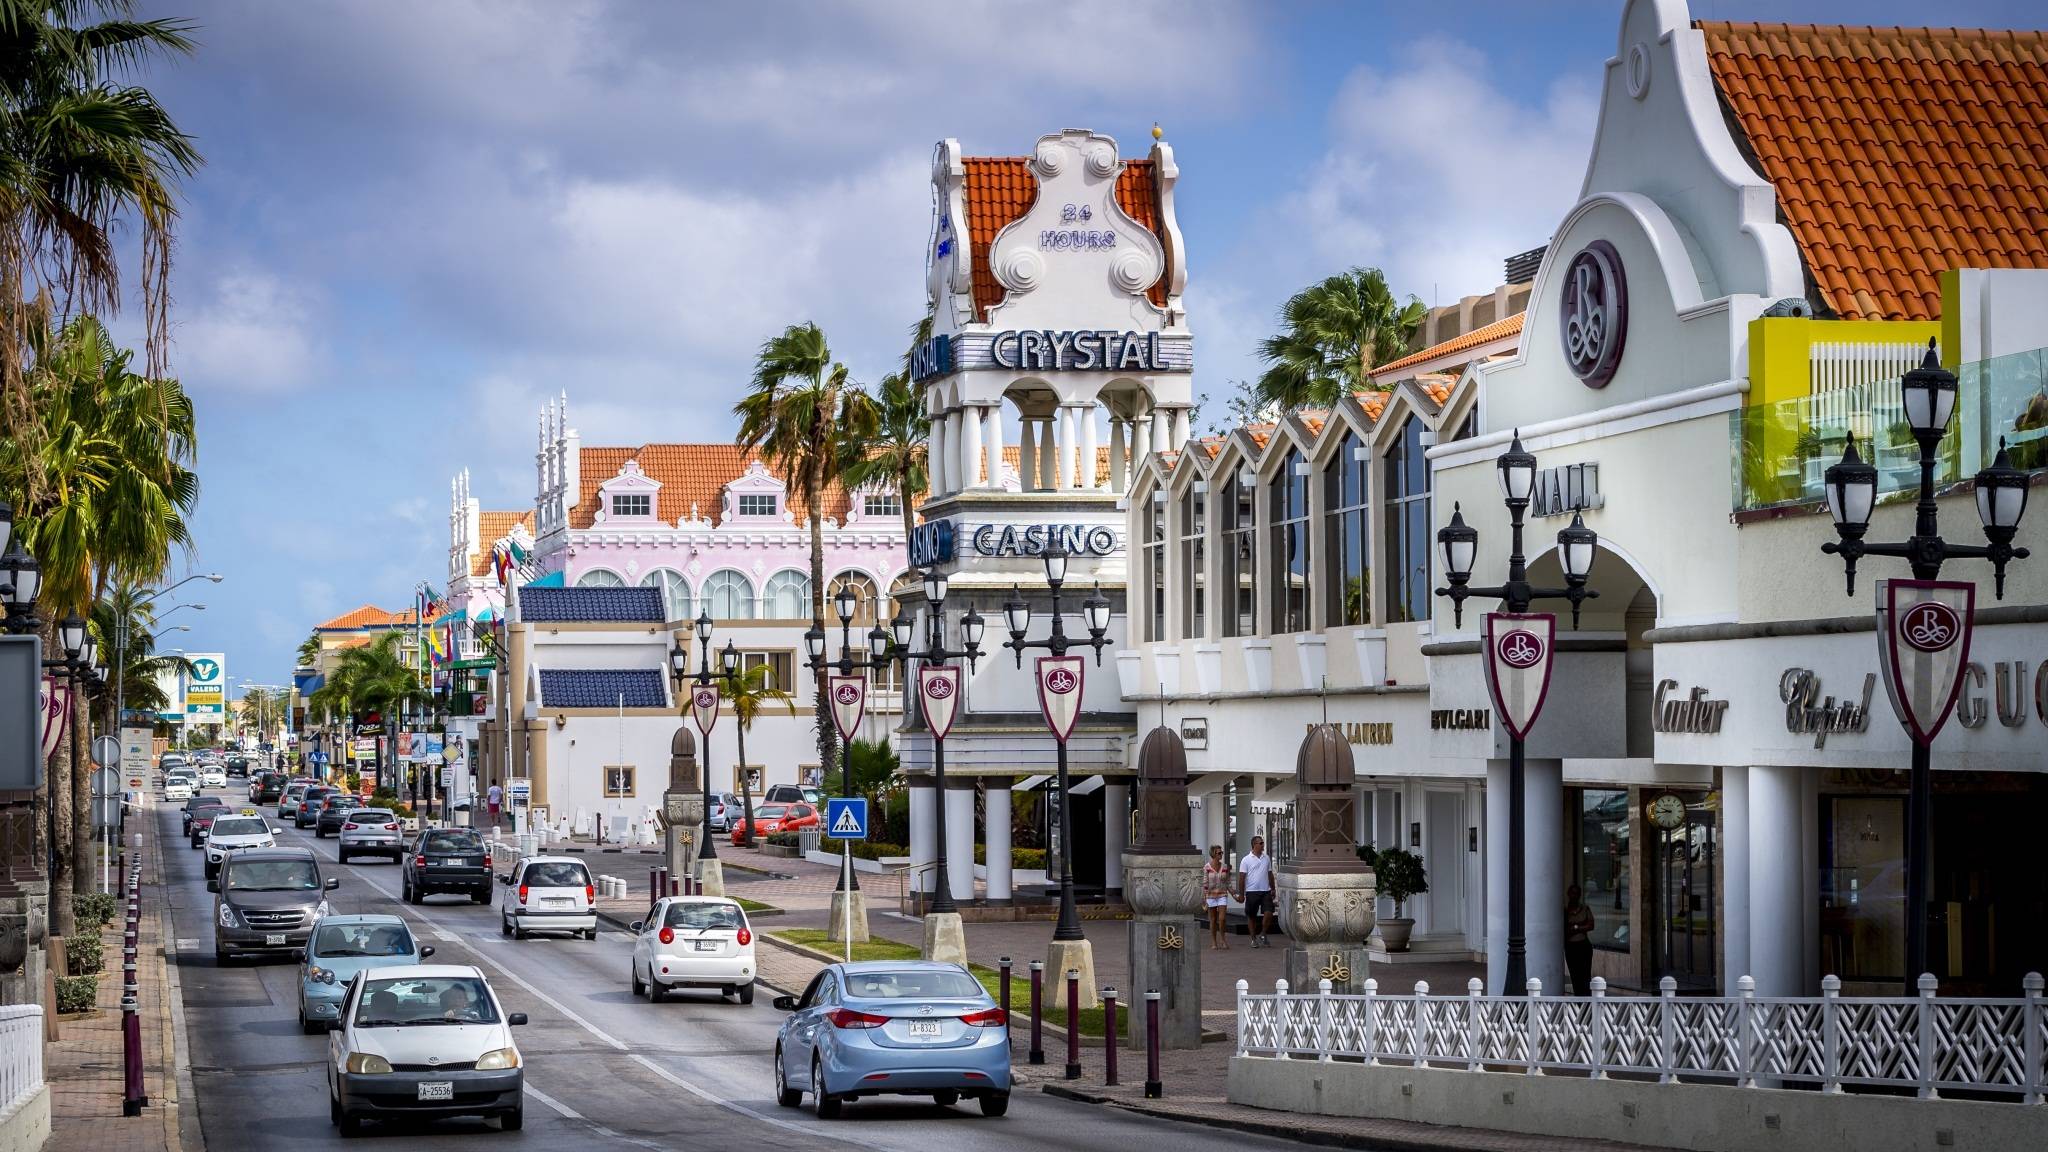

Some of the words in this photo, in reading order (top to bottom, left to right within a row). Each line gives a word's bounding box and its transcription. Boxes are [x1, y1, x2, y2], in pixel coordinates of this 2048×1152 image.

[1061, 203, 1092, 223] 24
[1040, 230, 1116, 250] HOURS
[992, 330, 1170, 370] CRYSTAL
[1531, 462, 1601, 518] MALL
[907, 521, 943, 568] CASINO
[1652, 679, 1729, 733] Cartier
[1431, 709, 1490, 731] BVLGARI
[1347, 722, 1393, 745] LAUREN
[422, 1086, 451, 1097] A-25536
